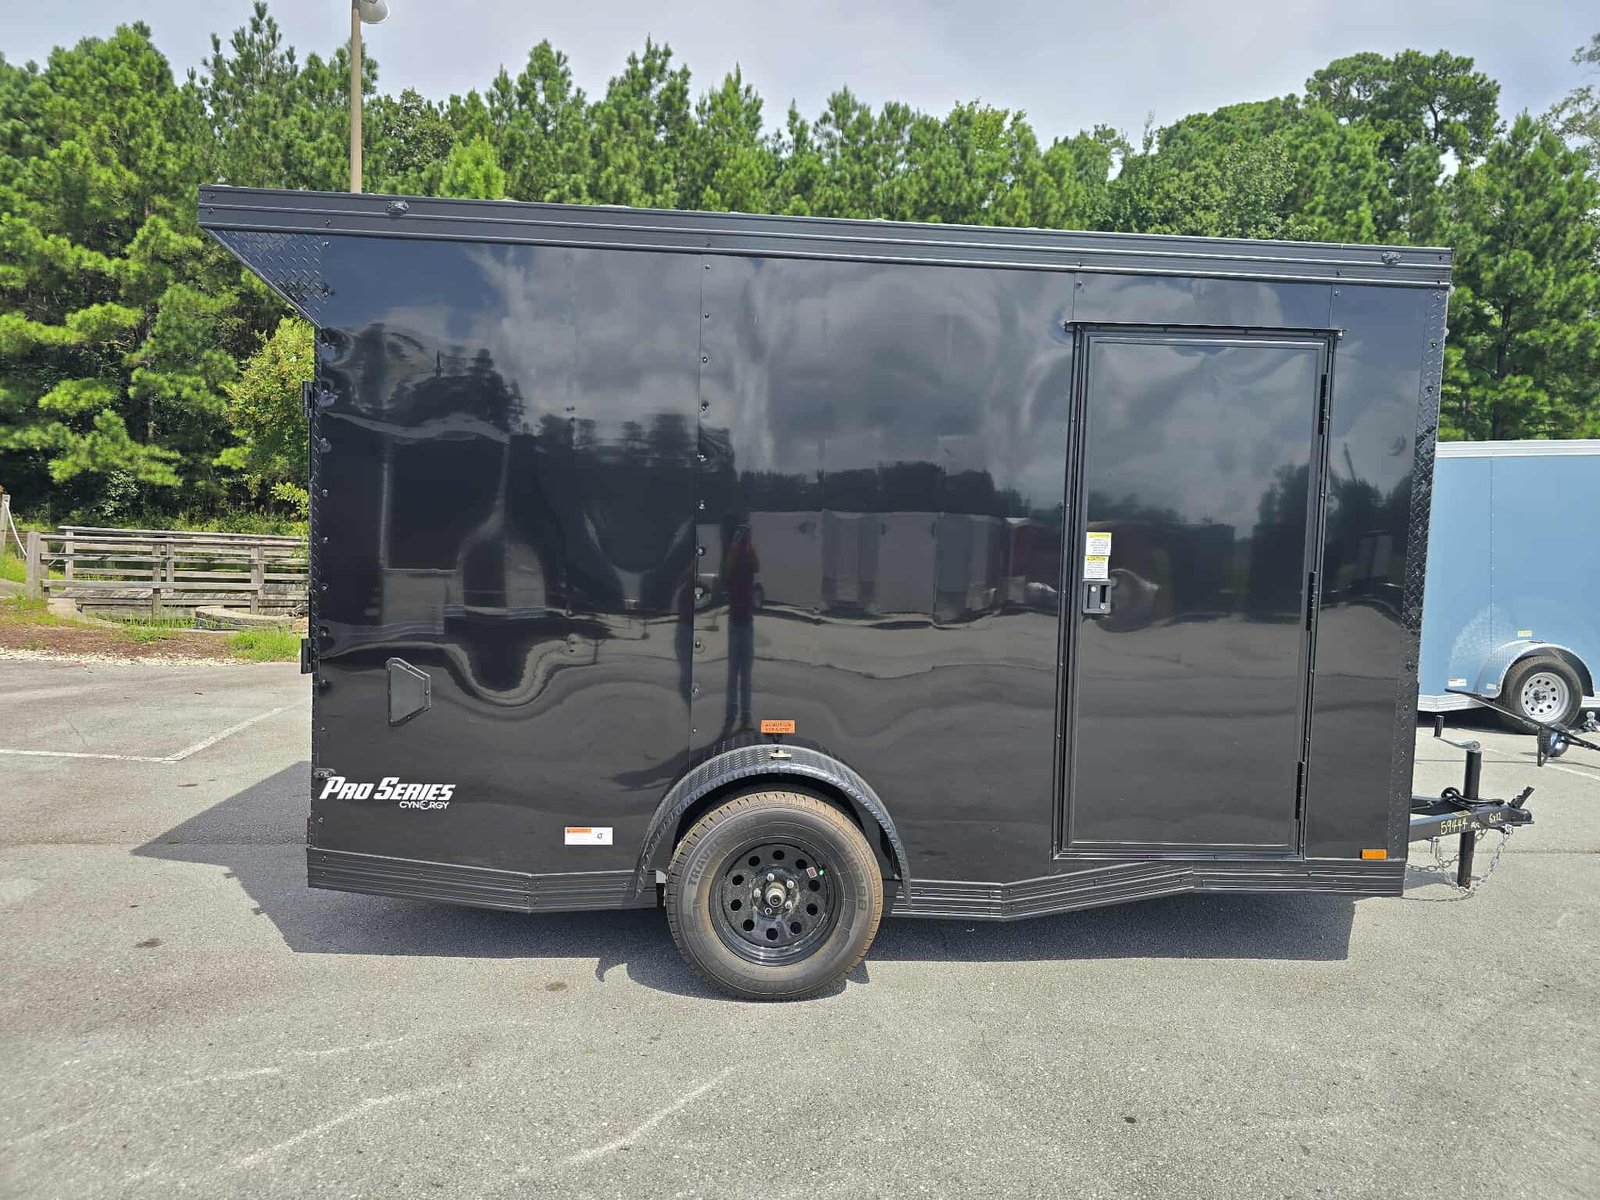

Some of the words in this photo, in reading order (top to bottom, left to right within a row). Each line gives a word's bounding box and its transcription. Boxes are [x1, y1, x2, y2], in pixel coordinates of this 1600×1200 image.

[319, 776, 375, 799] PRO
[373, 777, 456, 800] SERIES
[399, 800, 449, 810] CYNERGY
